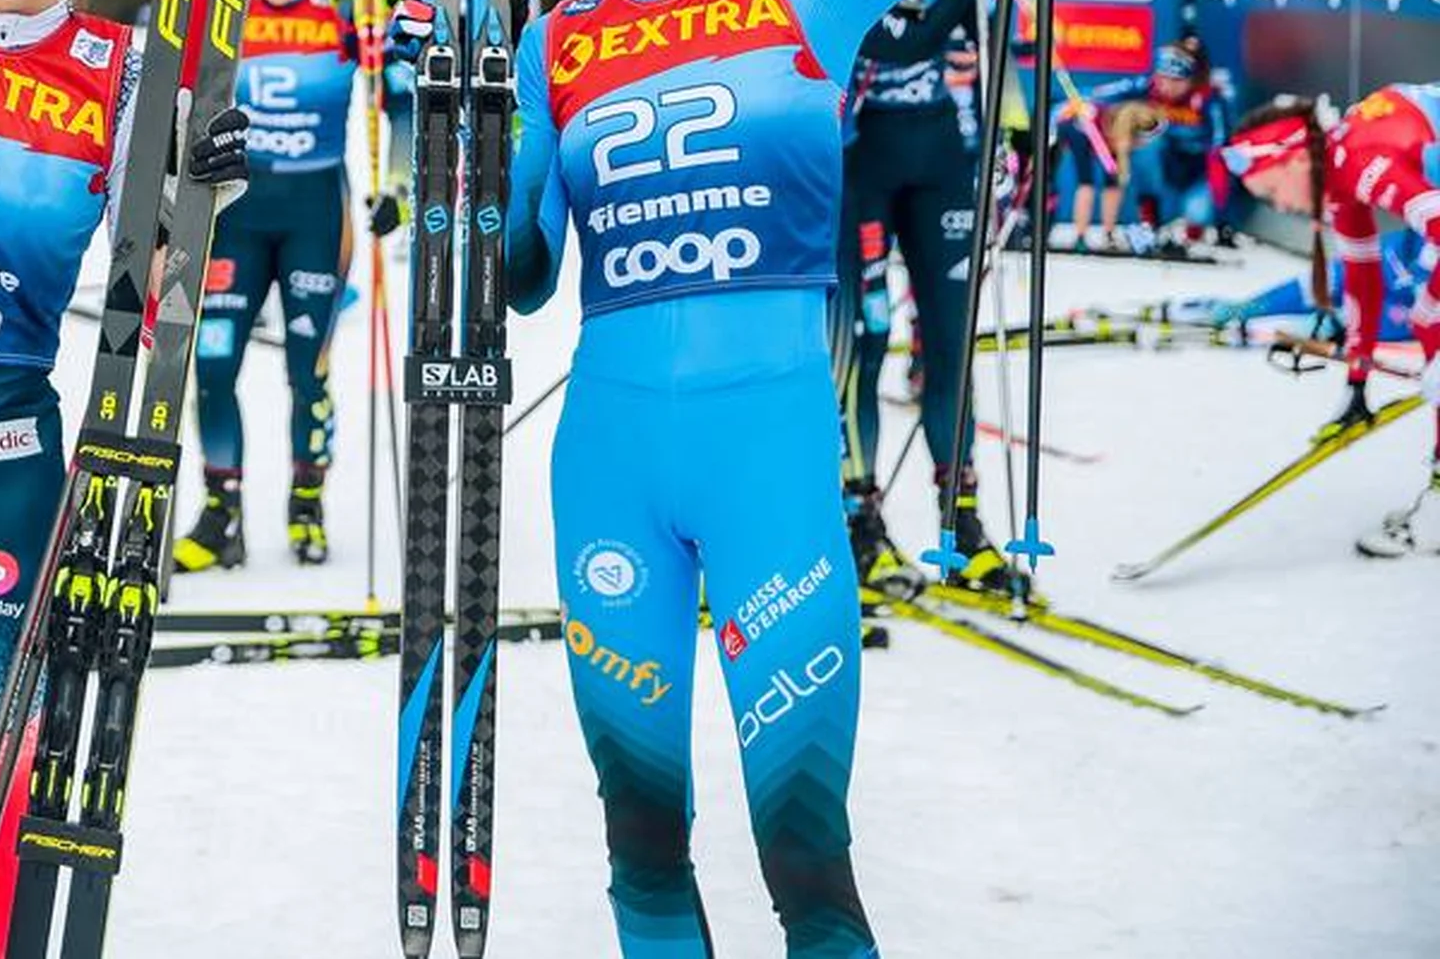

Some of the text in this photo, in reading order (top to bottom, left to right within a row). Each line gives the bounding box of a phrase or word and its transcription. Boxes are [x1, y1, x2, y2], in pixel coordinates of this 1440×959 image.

[247, 64, 298, 108] 12
[586, 83, 740, 187] 22
[587, 184, 772, 234] fiemme
[603, 227, 761, 288] coop
[79, 444, 174, 469] FISCHER
[738, 573, 789, 625] CAISSE
[746, 557, 833, 641] D'EPARGNE
[739, 646, 844, 748] odlo
[21, 833, 116, 859] FISCHER
